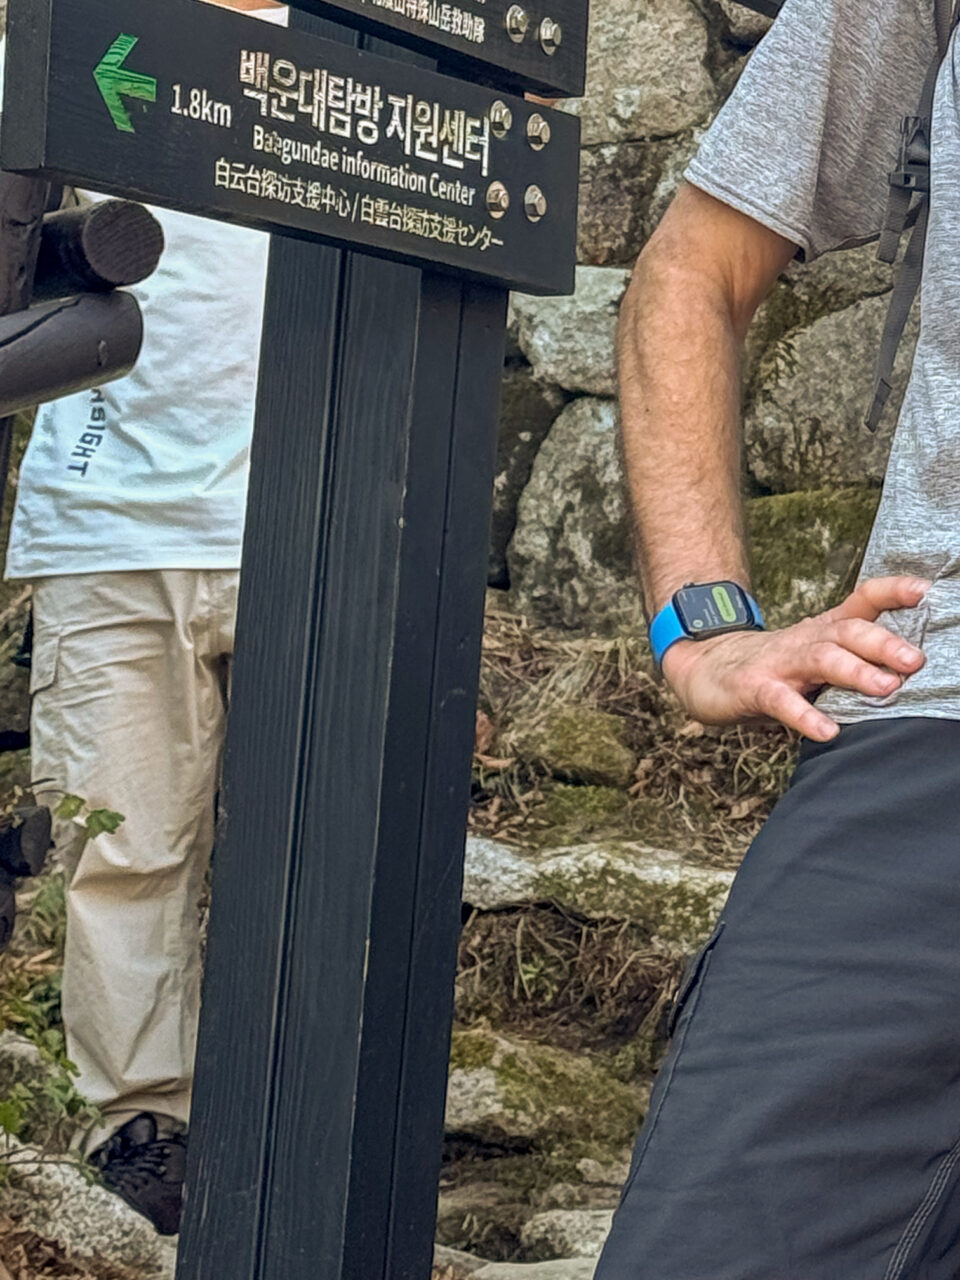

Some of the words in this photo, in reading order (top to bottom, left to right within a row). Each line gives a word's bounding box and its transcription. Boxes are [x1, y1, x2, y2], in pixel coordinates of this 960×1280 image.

[170, 83, 232, 128] 1.8km
[252, 124, 339, 171] Baegundae
[429, 172, 477, 207] Center
